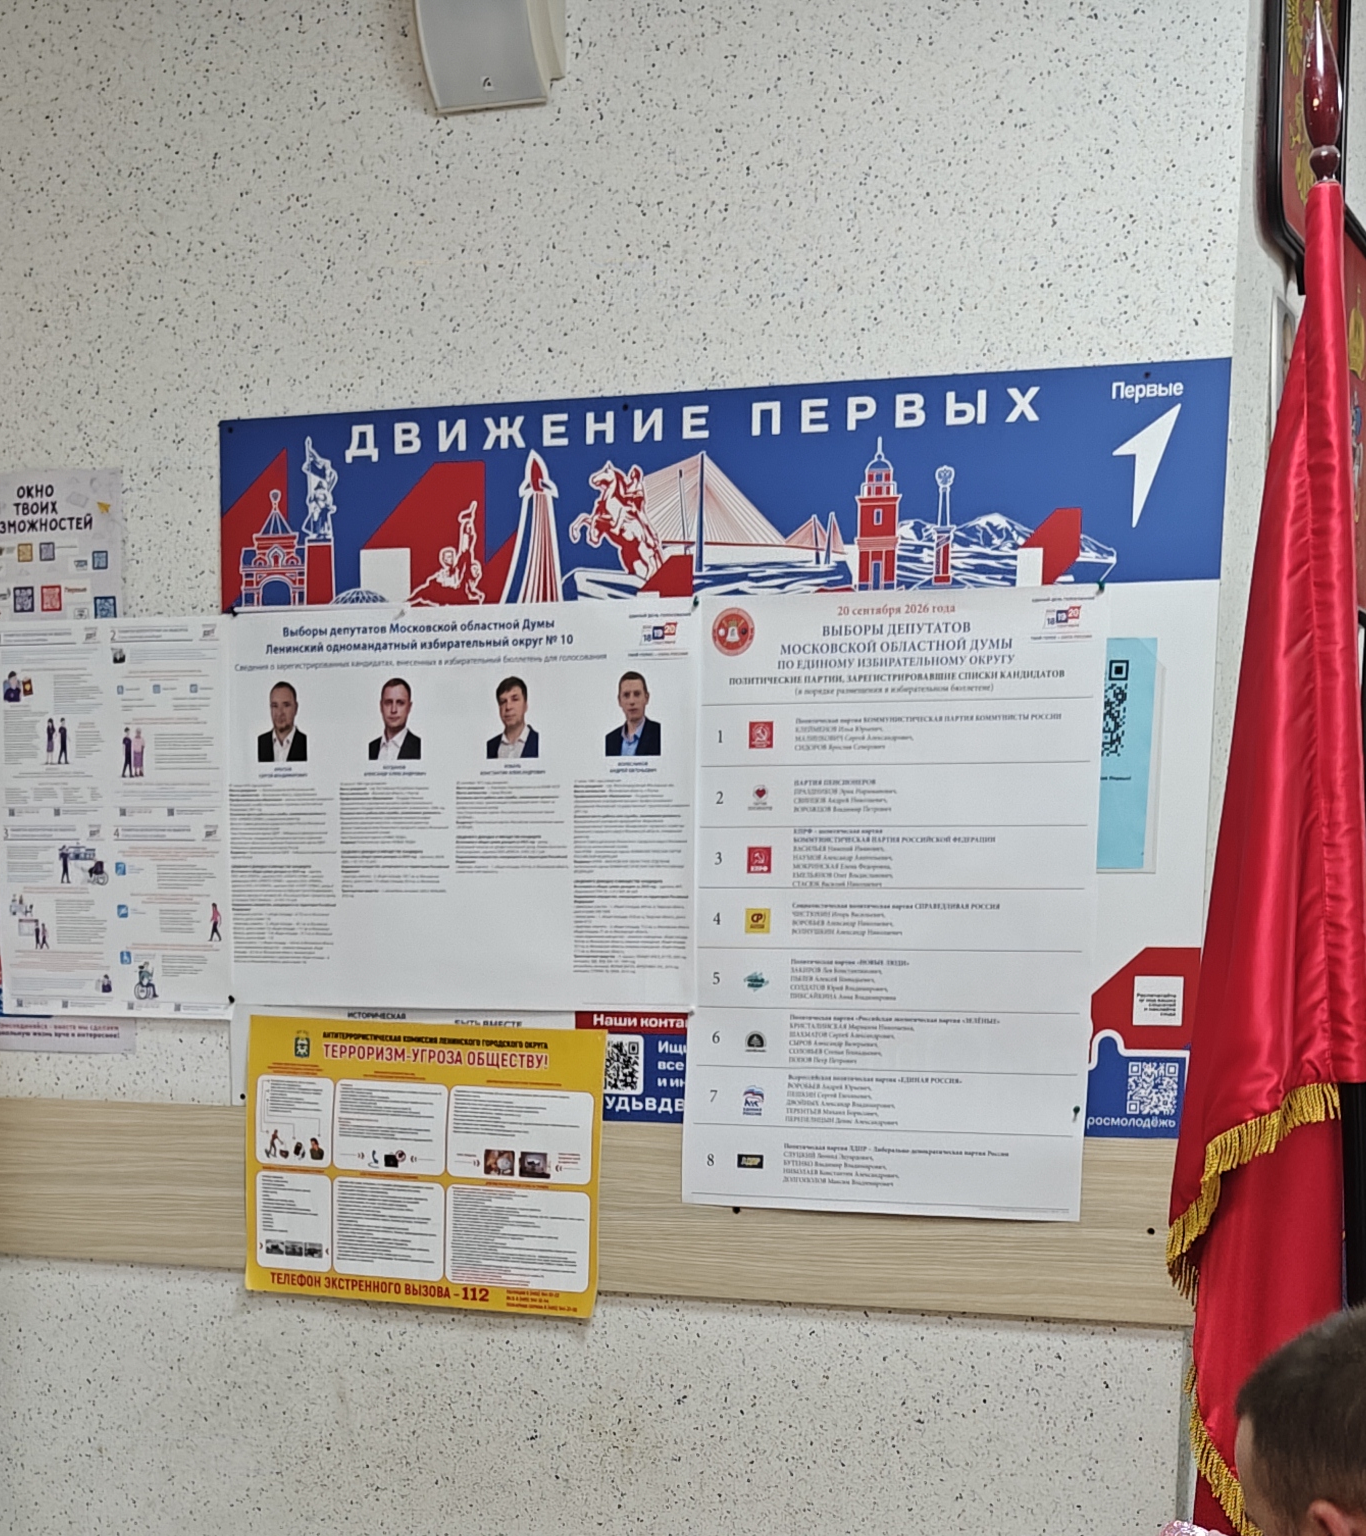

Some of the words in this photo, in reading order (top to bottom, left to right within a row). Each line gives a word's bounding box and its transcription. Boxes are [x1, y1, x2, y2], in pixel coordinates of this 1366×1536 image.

[1112, 381, 1184, 404] Первые
[345, 405, 709, 463] ДВИЖЕНИЕ
[751, 386, 1040, 436] ПЕРВЫХ
[16, 484, 54, 499] ОКНО
[13, 501, 58, 516] ТВОИХ
[837, 606, 849, 616] 20
[852, 605, 901, 618] сентября
[905, 604, 929, 614] 2026
[932, 605, 956, 614] года
[283, 626, 327, 639] Выборы
[330, 625, 387, 637] депутатов
[390, 620, 458, 634] Московской
[460, 619, 520, 631] областной
[522, 618, 555, 632] Думы
[822, 624, 883, 637] ВЫБОРЫ
[887, 622, 971, 637] ДЕПУТАТОВ
[265, 641, 323, 655] Ленинский
[326, 639, 418, 653] одномандатный
[421, 636, 509, 651] избирательный
[512, 636, 543, 649] округ
[560, 634, 573, 645] 10
[780, 639, 876, 655] МОСКОВСКОЙ
[880, 637, 966, 652] ОБЛАСТНОЙ
[969, 638, 1013, 653] ДУМЫ
[777, 659, 794, 670] ПО
[797, 658, 855, 671] ЕДИНОМУ
[857, 656, 966, 668] ИЗБИРАТЕЛЬНОМУ
[969, 654, 1015, 666] ОКРУГУ
[729, 675, 802, 686] ПОЛИТИЧЕСКИЕ
[846, 672, 956, 684] ЗАРЕГИСТРИРОВАВШИЕ
[958, 671, 998, 681] СПИСКИ
[999, 670, 1065, 680] КАНДИДАТОВ
[717, 730, 723, 743] 1
[716, 791, 724, 805] 2
[714, 851, 723, 865] 3
[713, 912, 721, 925] 4
[712, 971, 721, 985] 5
[593, 1014, 639, 1027] Наши
[640, 1017, 687, 1028] конта
[712, 1030, 720, 1044] 6
[324, 1044, 463, 1065] ТЕРРОРИЗМ-УГРОЗА
[467, 1051, 548, 1069] ОБЩЕСТВУ!
[657, 1061, 685, 1071] все
[657, 1078, 667, 1087] и
[710, 1089, 718, 1103] 7
[1087, 1116, 1176, 1129] росмолодёжь
[707, 1153, 715, 1166] 8
[270, 1272, 321, 1288] ТЕЛЕФОН
[324, 1276, 401, 1294] ЭКСТРЕННОГО
[404, 1283, 450, 1299] ВЫЗОВА
[462, 1287, 490, 1302] 112
